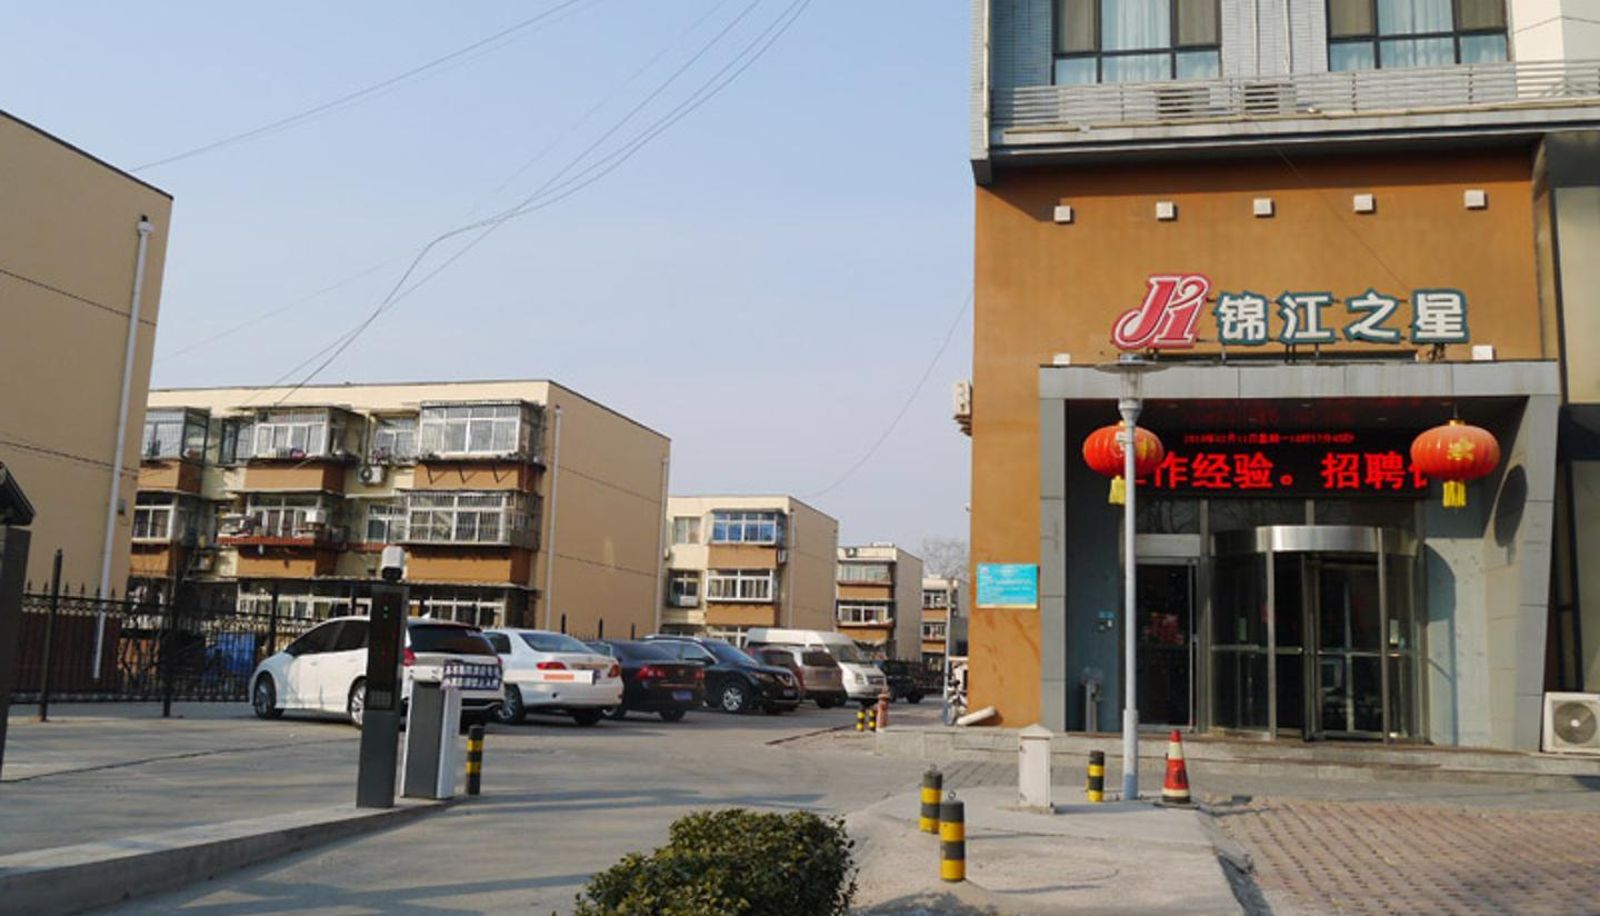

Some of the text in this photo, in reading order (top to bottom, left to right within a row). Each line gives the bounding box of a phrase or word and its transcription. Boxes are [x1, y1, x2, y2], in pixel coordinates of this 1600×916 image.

[1215, 289, 1468, 342] 锦江之星
[1135, 451, 1428, 489] 作经验。招聘
